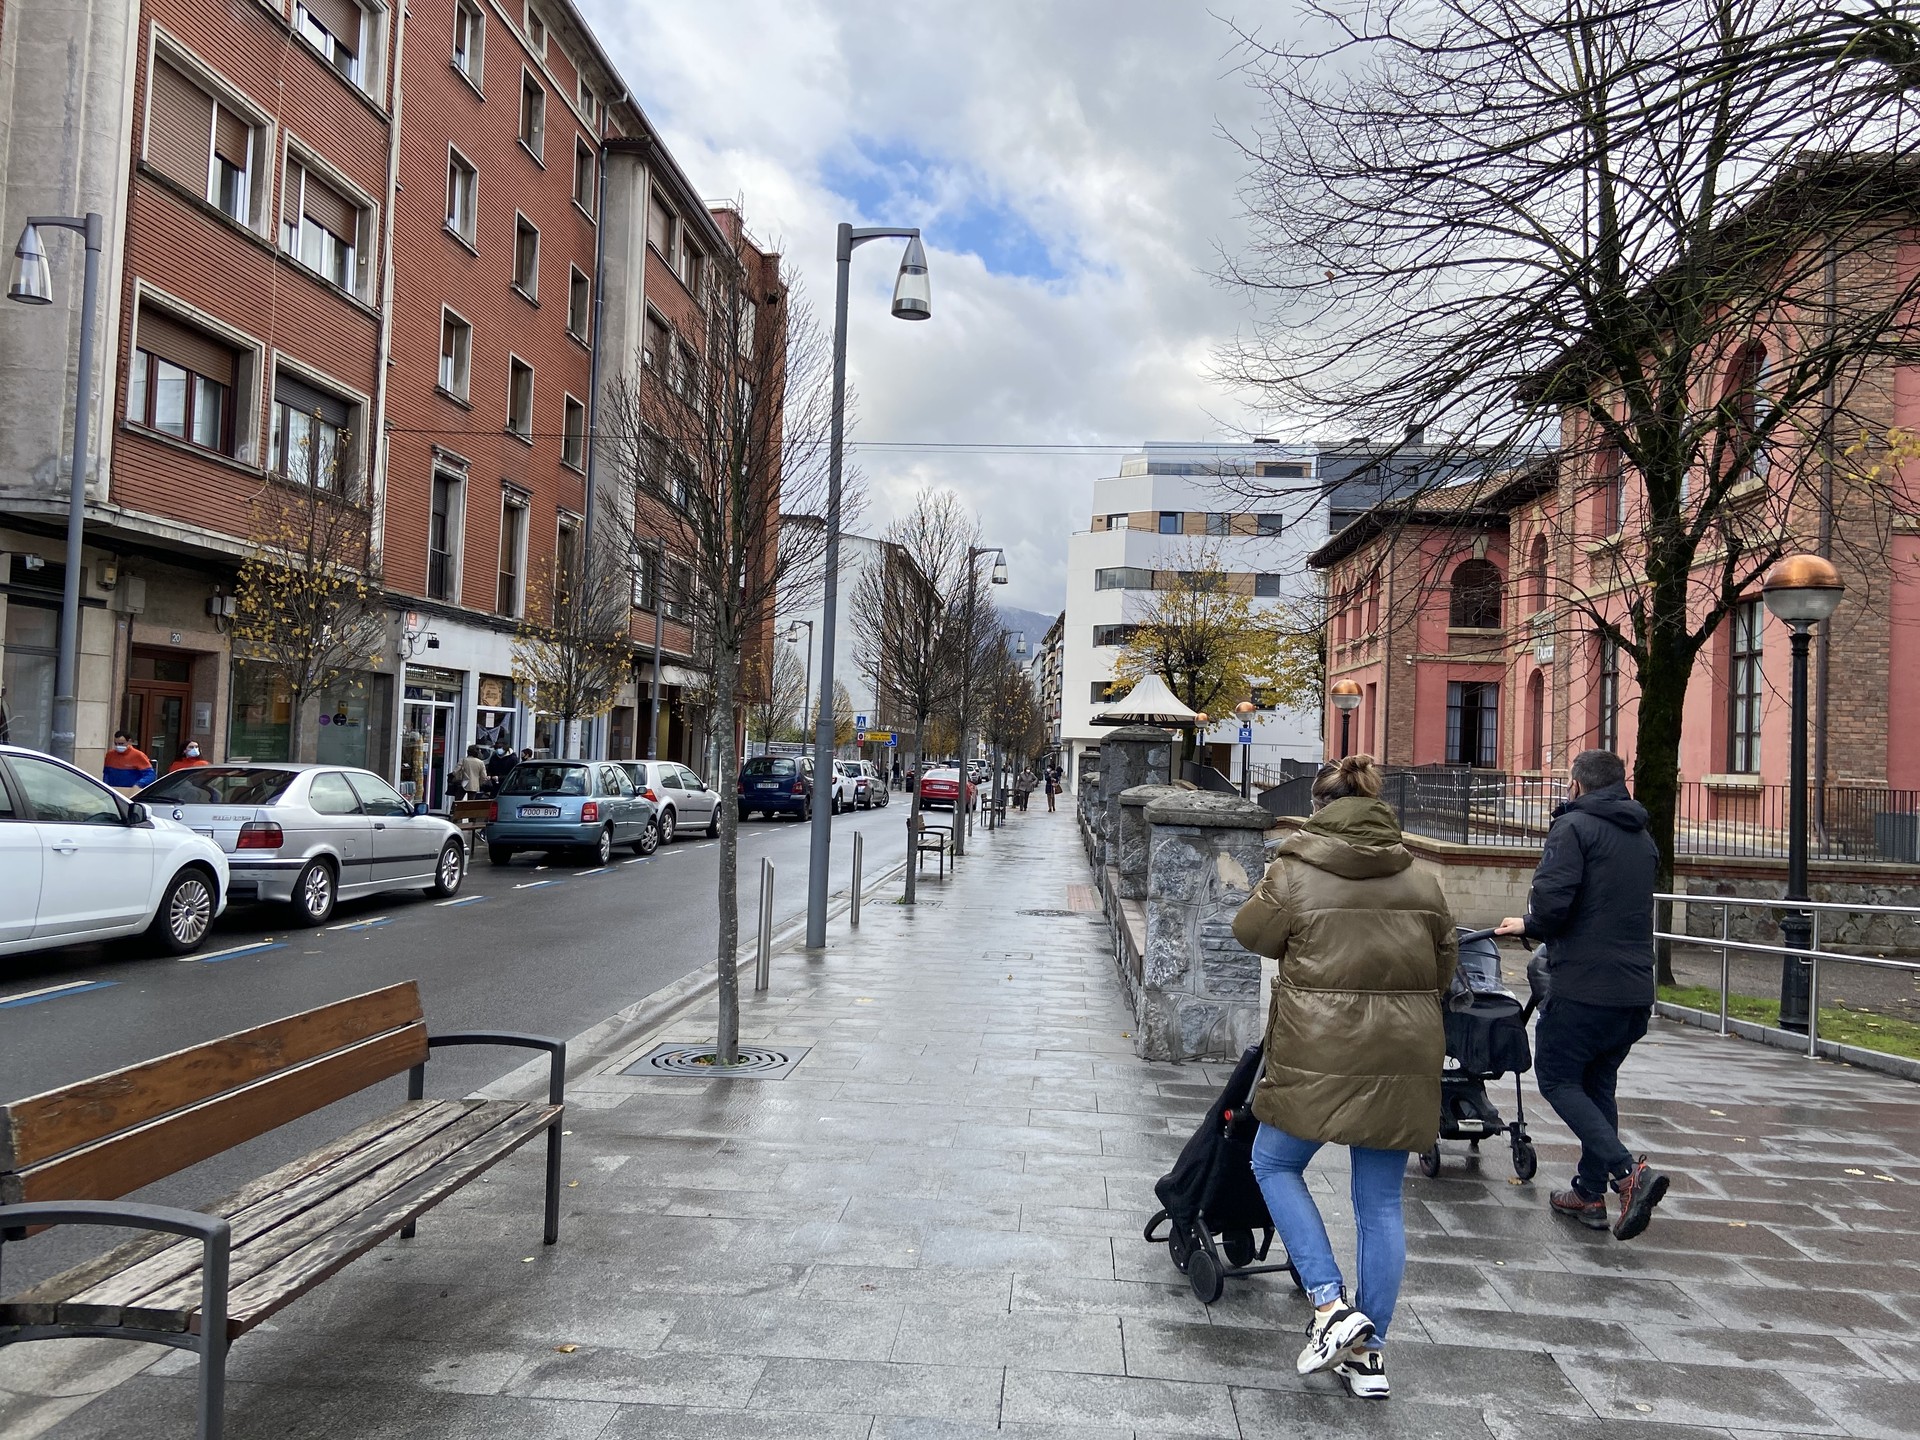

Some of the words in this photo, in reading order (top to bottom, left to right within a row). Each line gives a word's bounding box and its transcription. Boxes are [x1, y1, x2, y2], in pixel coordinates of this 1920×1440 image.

[172, 633, 181, 643] 20
[523, 808, 541, 816] 7000
[544, 808, 558, 816] BVR
